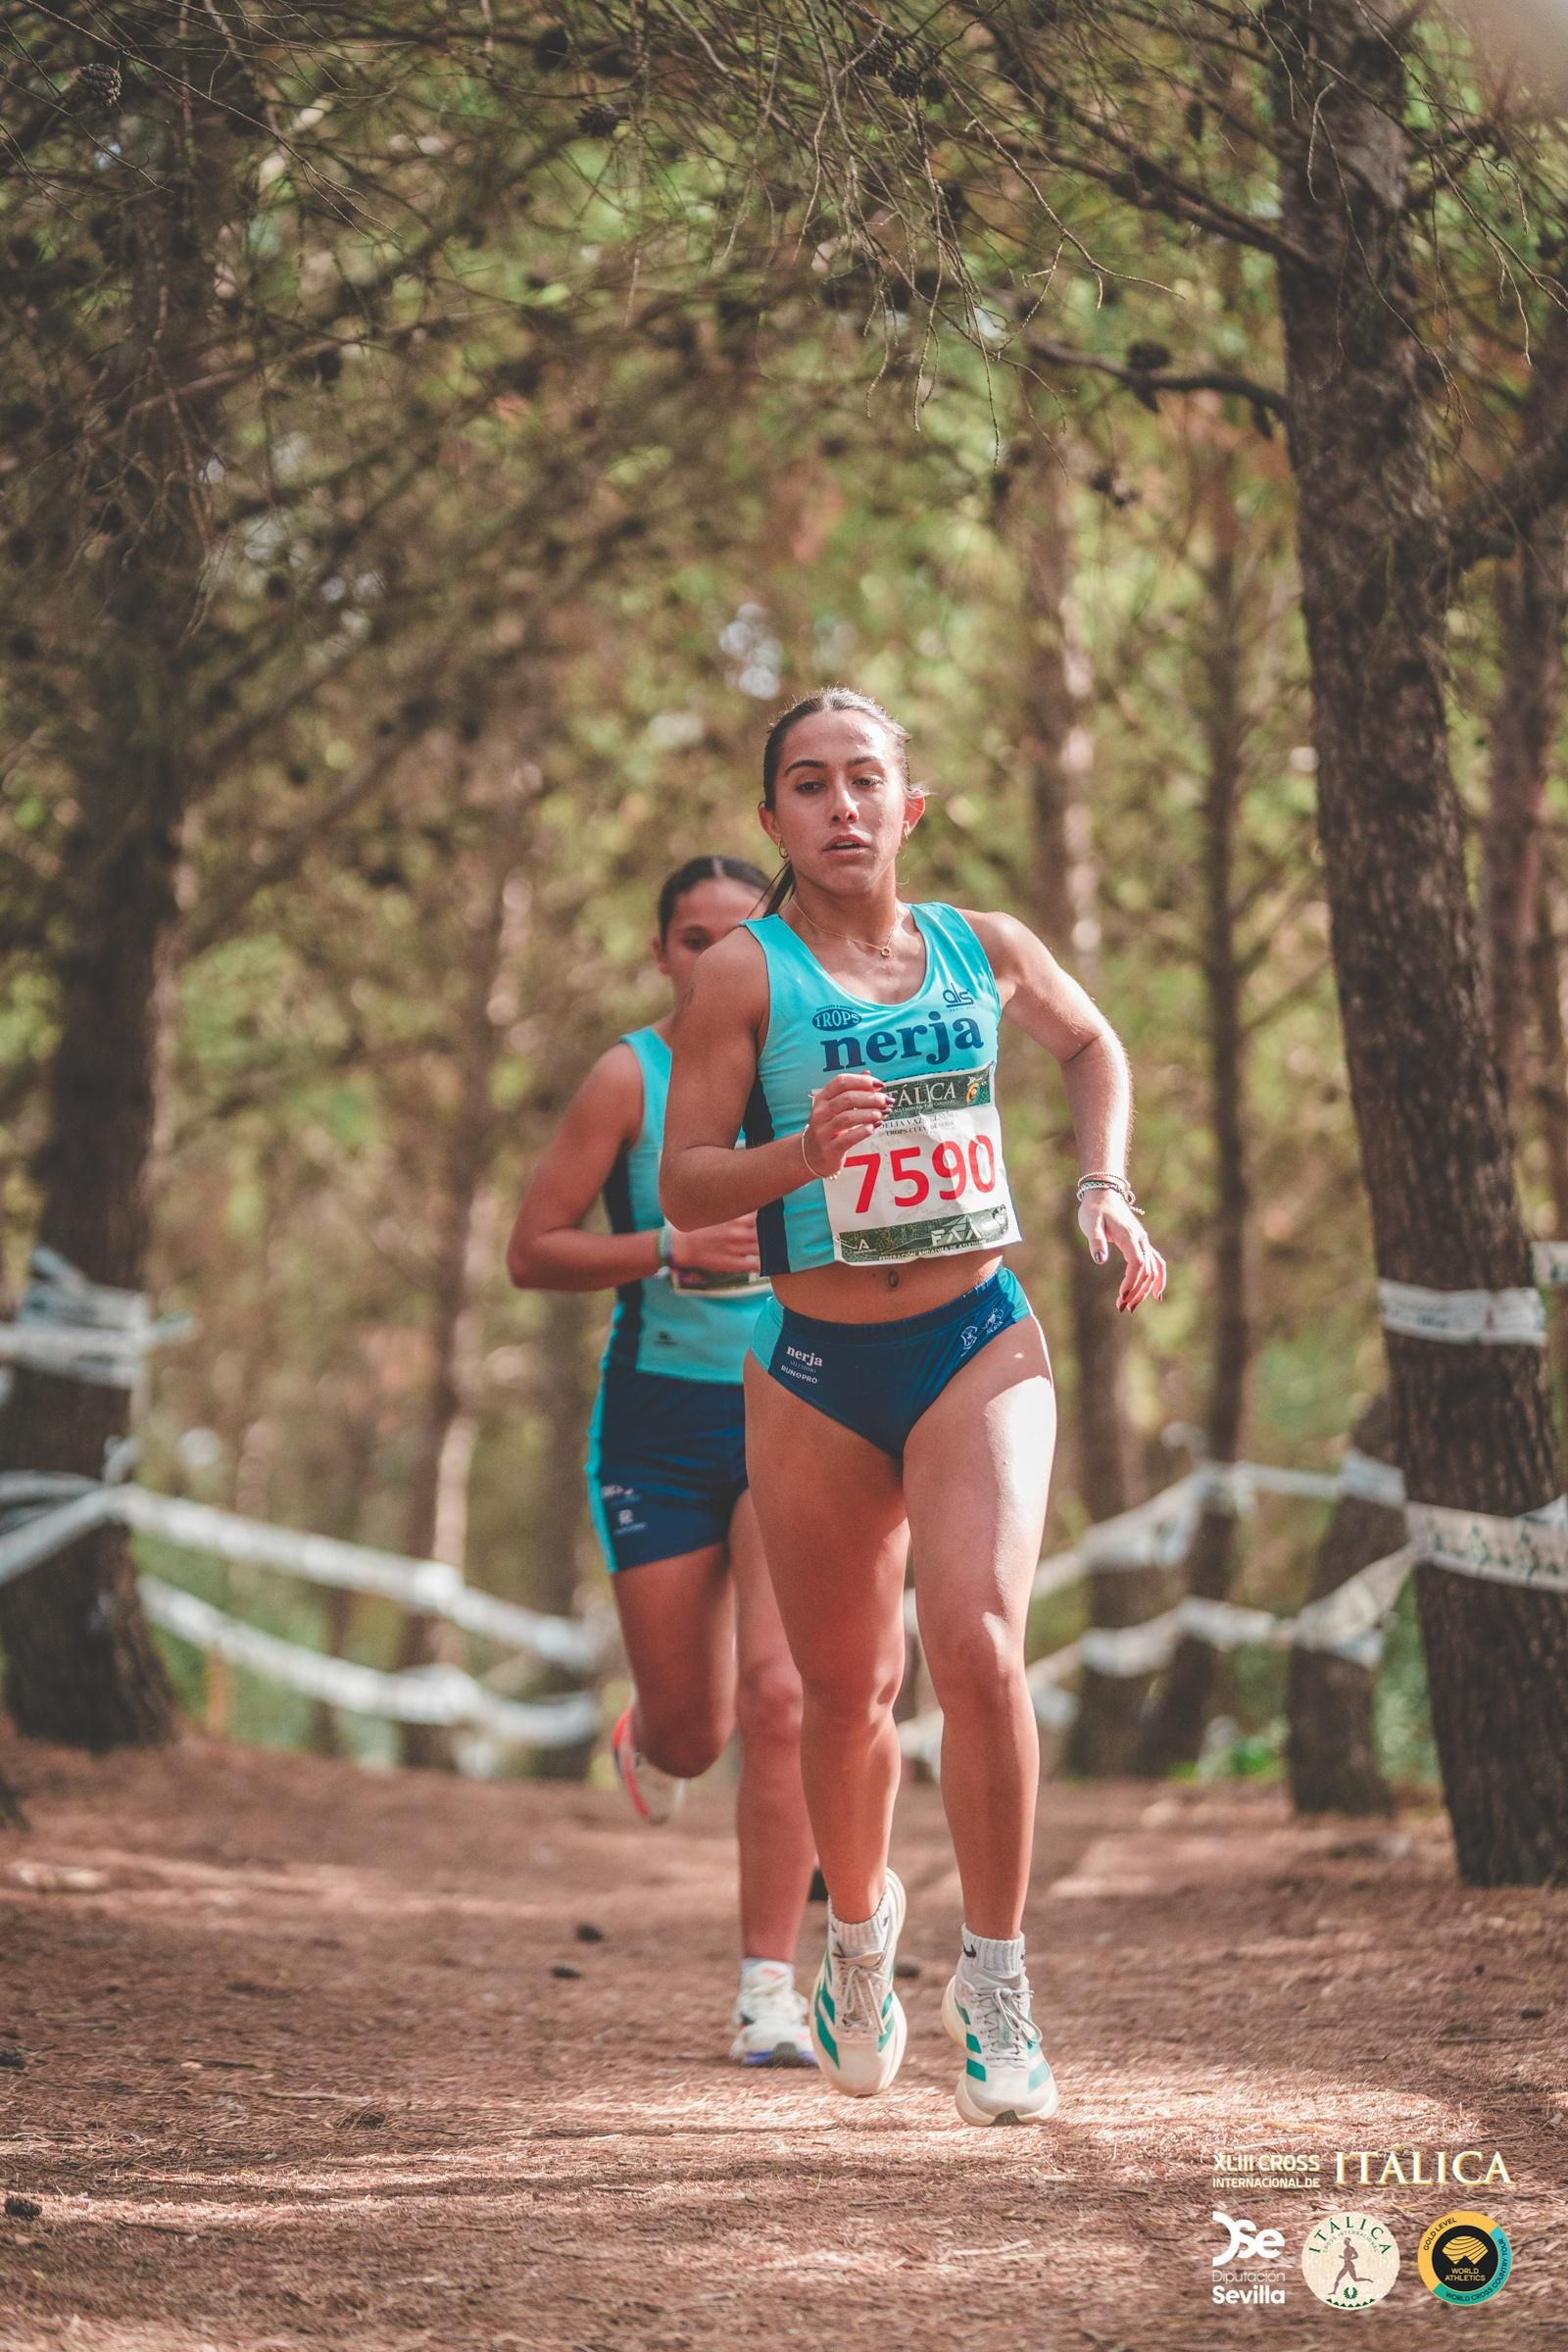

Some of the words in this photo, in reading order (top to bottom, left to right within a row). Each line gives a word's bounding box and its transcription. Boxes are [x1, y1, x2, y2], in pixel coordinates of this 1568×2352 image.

[814, 1009, 859, 1028] TROPS
[820, 1010, 984, 1072] nerja
[883, 1081, 956, 1107] TÁLICA
[844, 1134, 996, 1214] 7590
[786, 1346, 823, 1366] nerja
